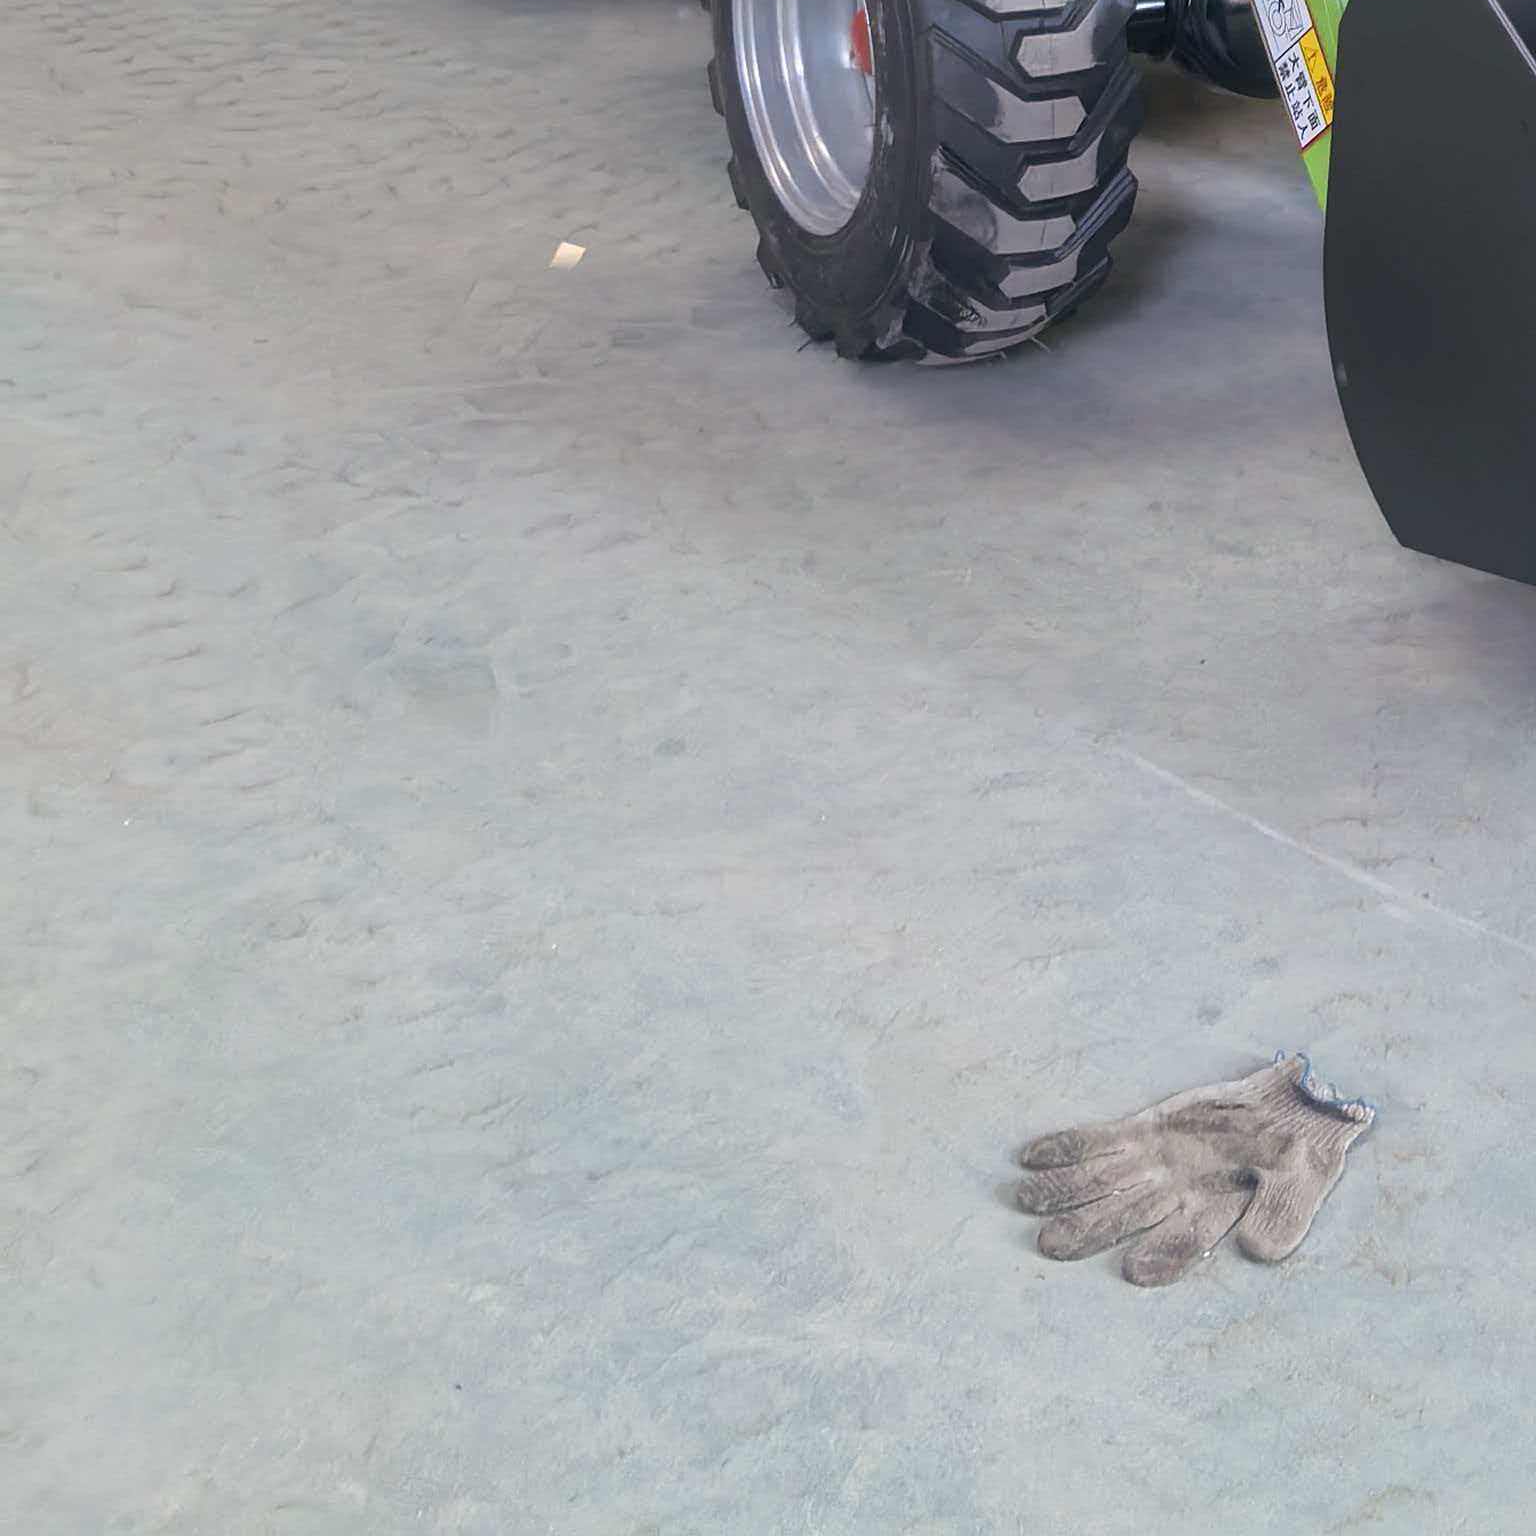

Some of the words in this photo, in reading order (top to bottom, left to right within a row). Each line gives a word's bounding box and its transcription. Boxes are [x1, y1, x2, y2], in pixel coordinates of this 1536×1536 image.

[1278, 61, 1308, 141] 禁止站人
[1288, 51, 1321, 131] 大臂下面
